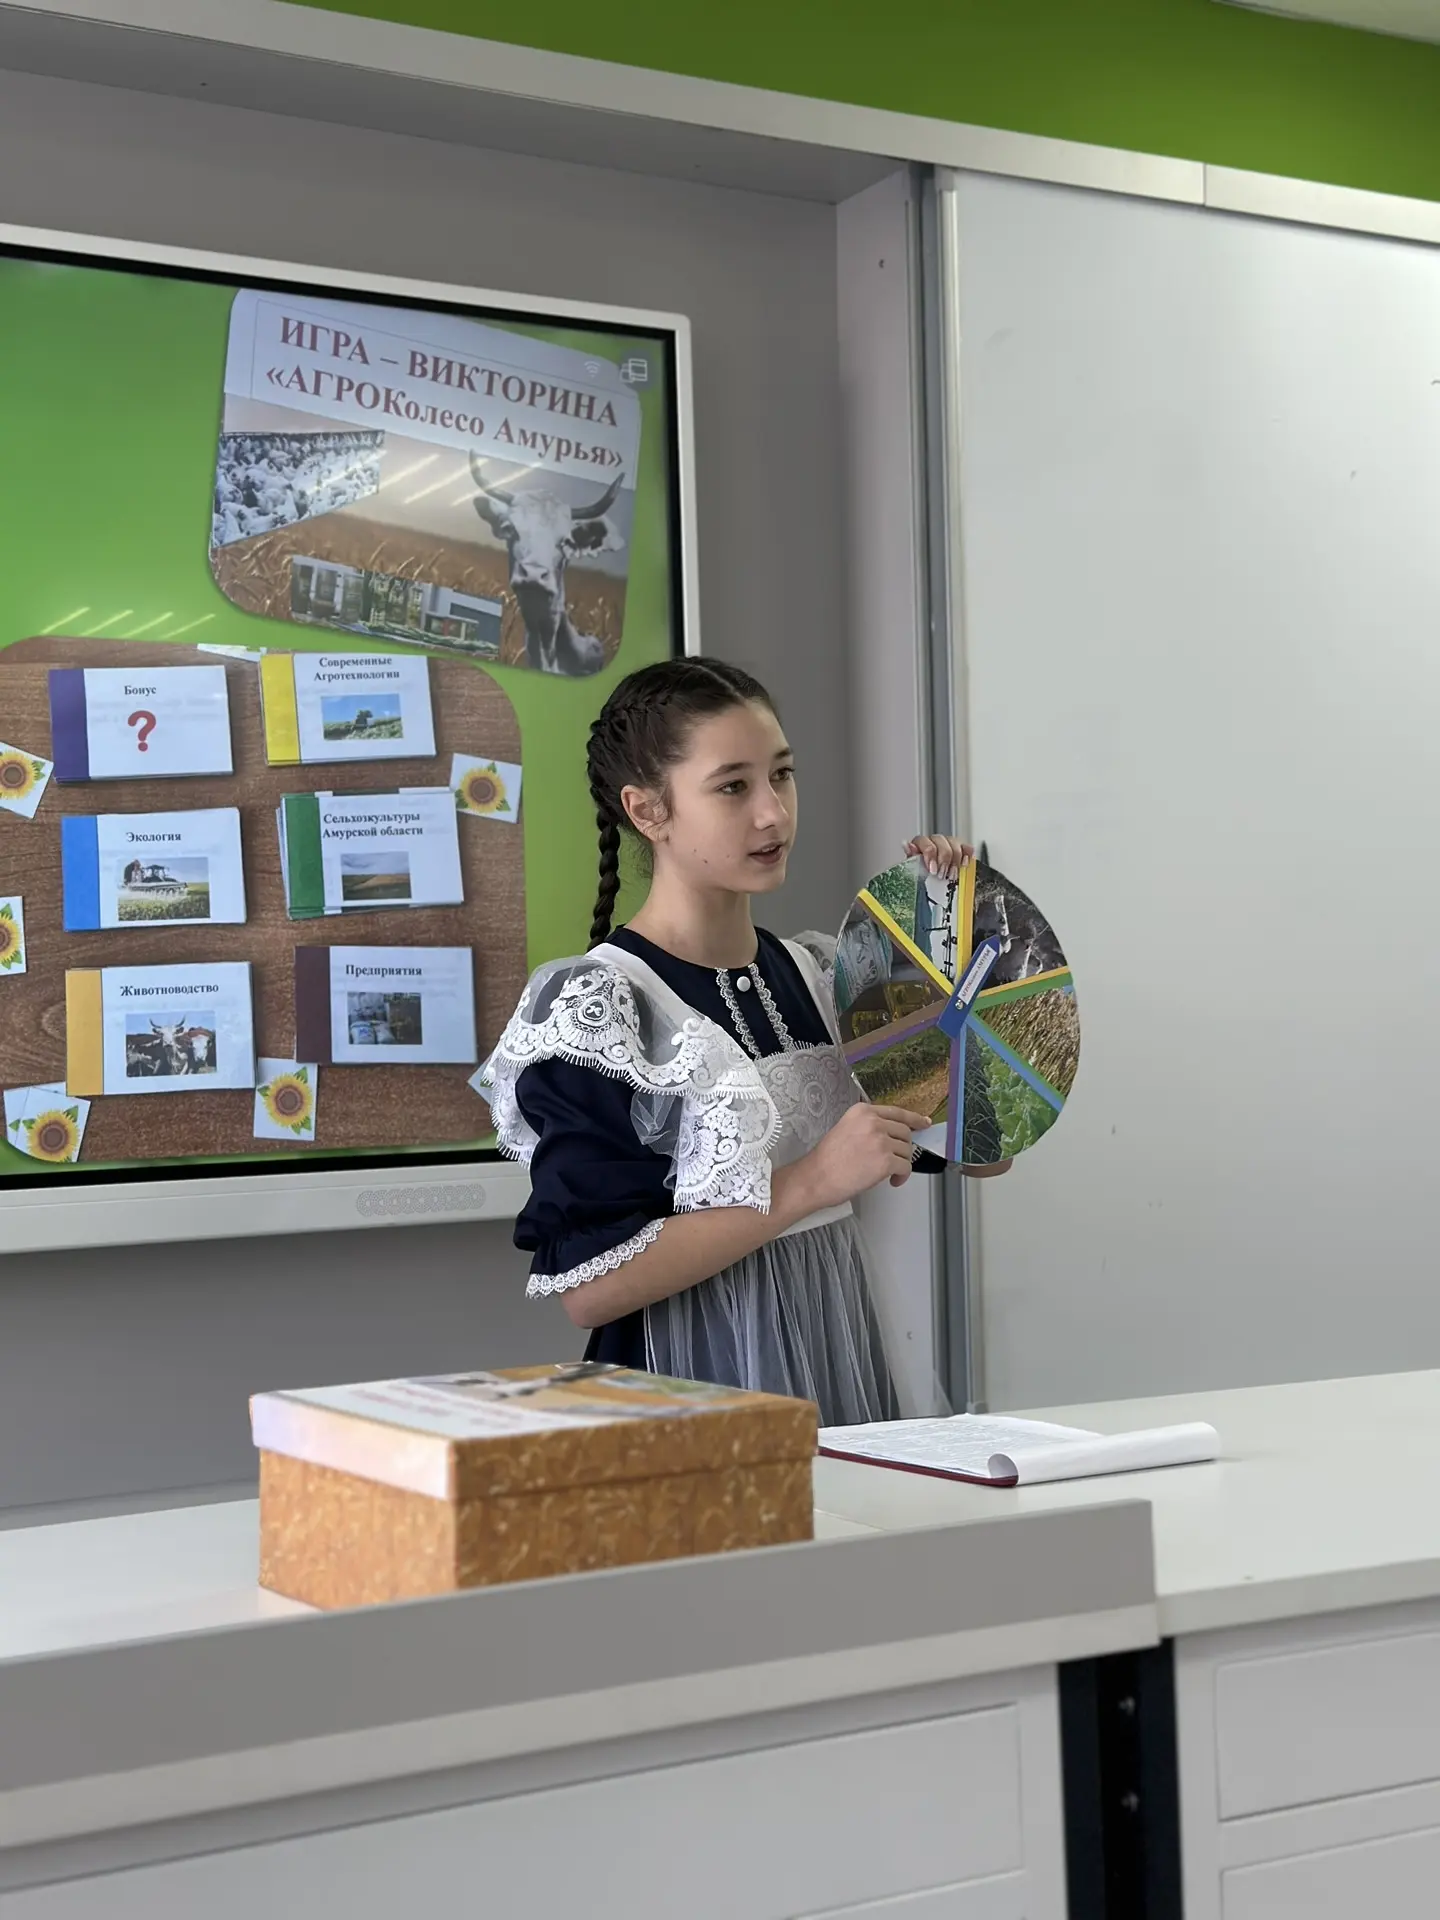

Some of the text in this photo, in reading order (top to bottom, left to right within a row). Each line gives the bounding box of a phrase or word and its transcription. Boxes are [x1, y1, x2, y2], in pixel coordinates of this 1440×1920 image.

[280, 316, 370, 365] ИГРА
[406, 349, 618, 427] ВИКТОРИНА
[266, 364, 623, 468] «АГРОКолесо Амурья»
[319, 657, 392, 669] Современные
[314, 671, 400, 683] Агротехнологии
[124, 685, 157, 697] Бонус
[323, 813, 421, 825] Сельхозкультуры
[126, 832, 182, 843] Экология
[323, 825, 424, 840] Амурской области
[345, 964, 422, 978] Предприятия
[120, 984, 219, 996] Животноводство
